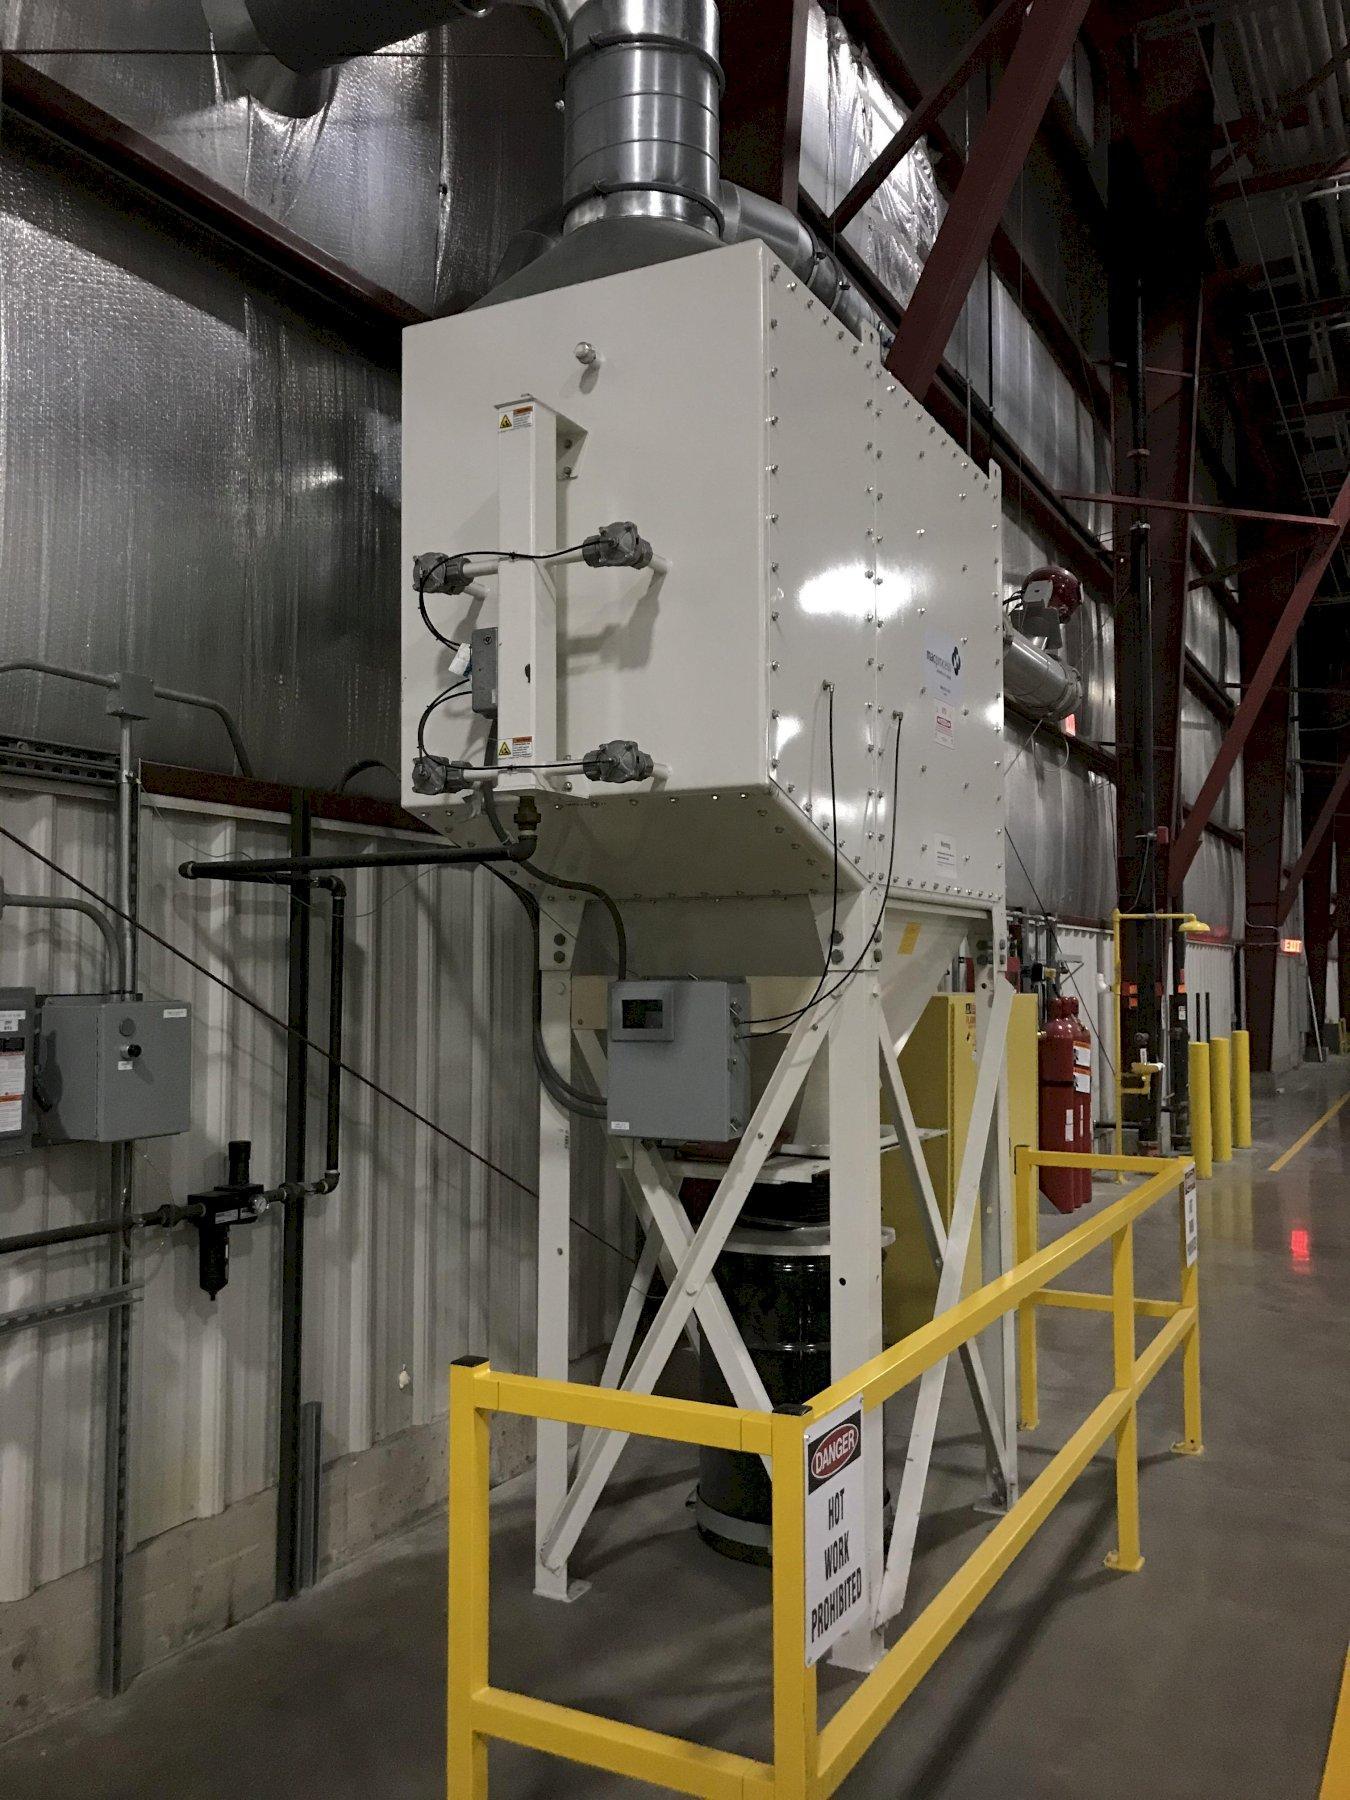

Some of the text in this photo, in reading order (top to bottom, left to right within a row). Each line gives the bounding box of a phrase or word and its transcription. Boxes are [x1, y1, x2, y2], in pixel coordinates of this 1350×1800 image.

[1284, 939, 1302, 953] EXIT
[815, 1428, 856, 1475] DANGER
[828, 1487, 845, 1531] HOT
[824, 1531, 850, 1581] WORK
[811, 1567, 862, 1643] PROHIBITED
